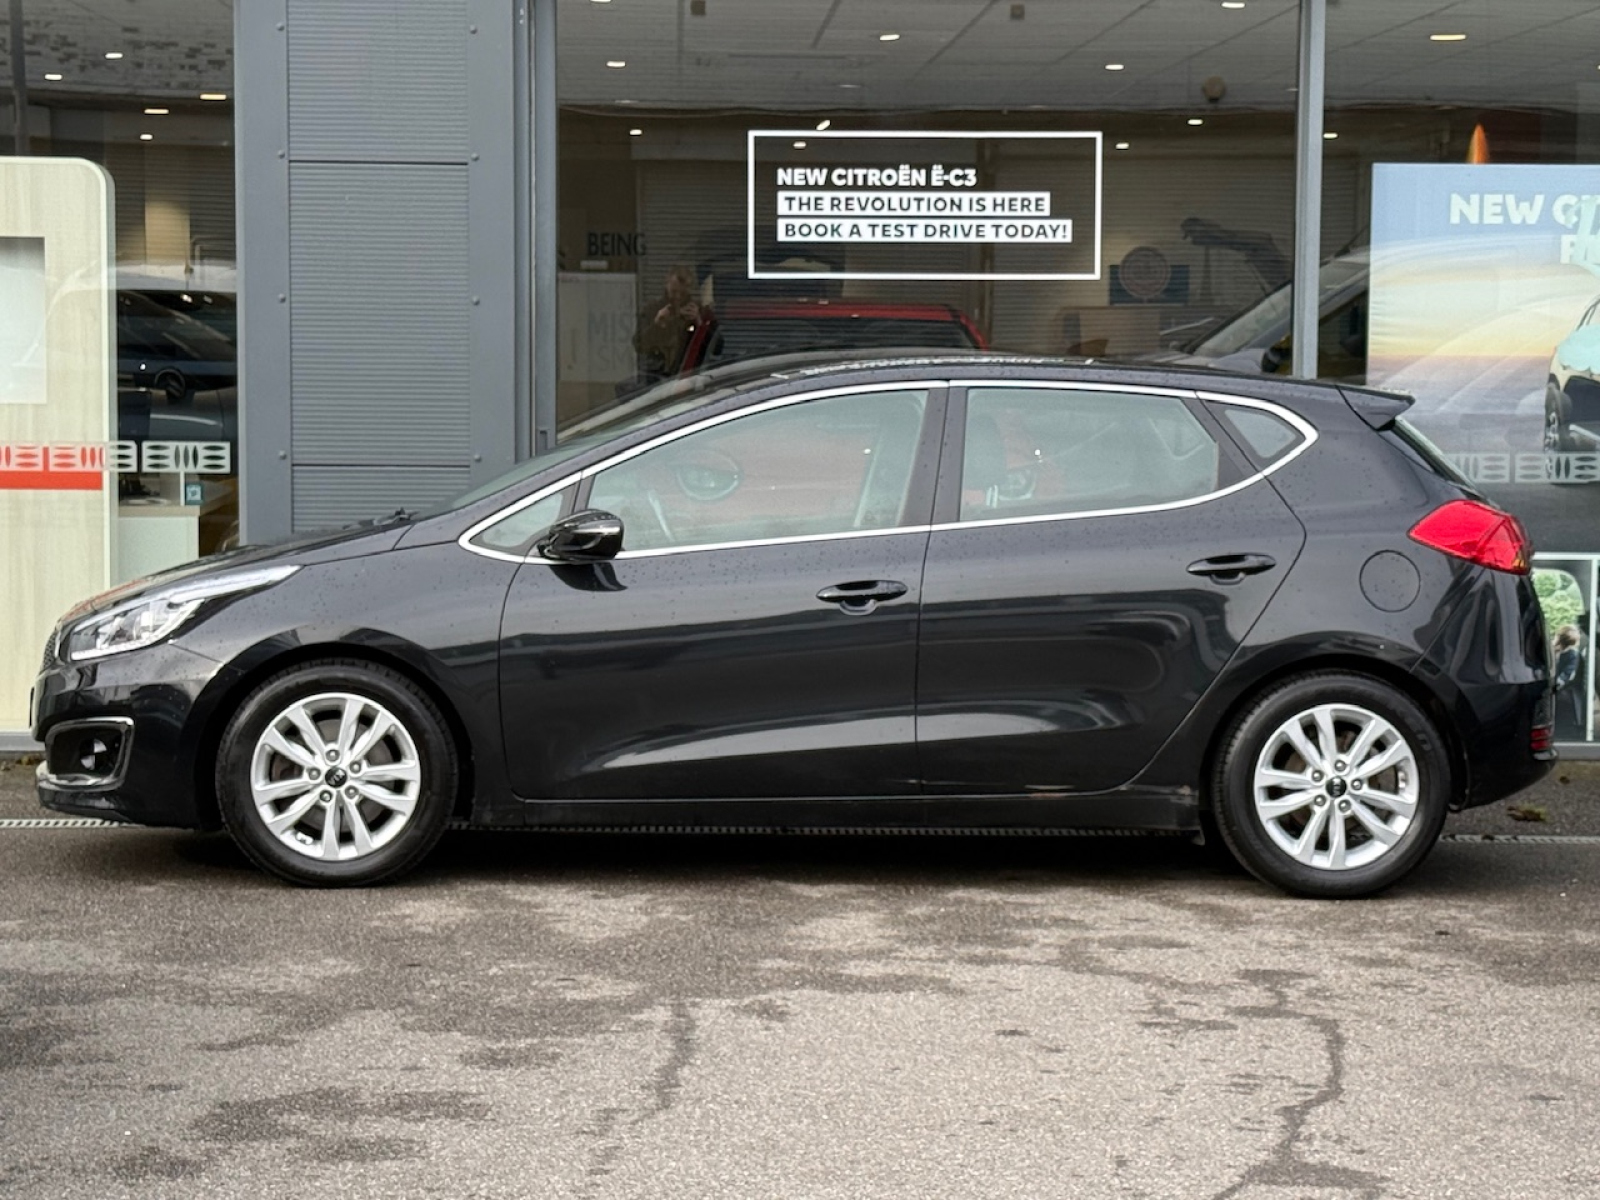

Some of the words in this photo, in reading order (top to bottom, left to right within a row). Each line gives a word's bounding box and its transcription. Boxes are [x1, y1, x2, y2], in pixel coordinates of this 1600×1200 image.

[777, 167, 828, 186] NEW
[831, 164, 927, 187] CITROËN
[930, 164, 977, 187] Ë-C3
[784, 196, 824, 212] THE
[830, 196, 962, 212] REVOLUTION
[969, 197, 986, 212] IS
[992, 197, 1045, 212] HERE
[1449, 193, 1546, 225] NEW
[785, 223, 842, 238] BOOK
[849, 223, 862, 238] A
[867, 223, 918, 238] TEST
[924, 224, 986, 238] DRIVE
[991, 224, 1066, 239] TODAY!
[587, 232, 647, 256] BEING
